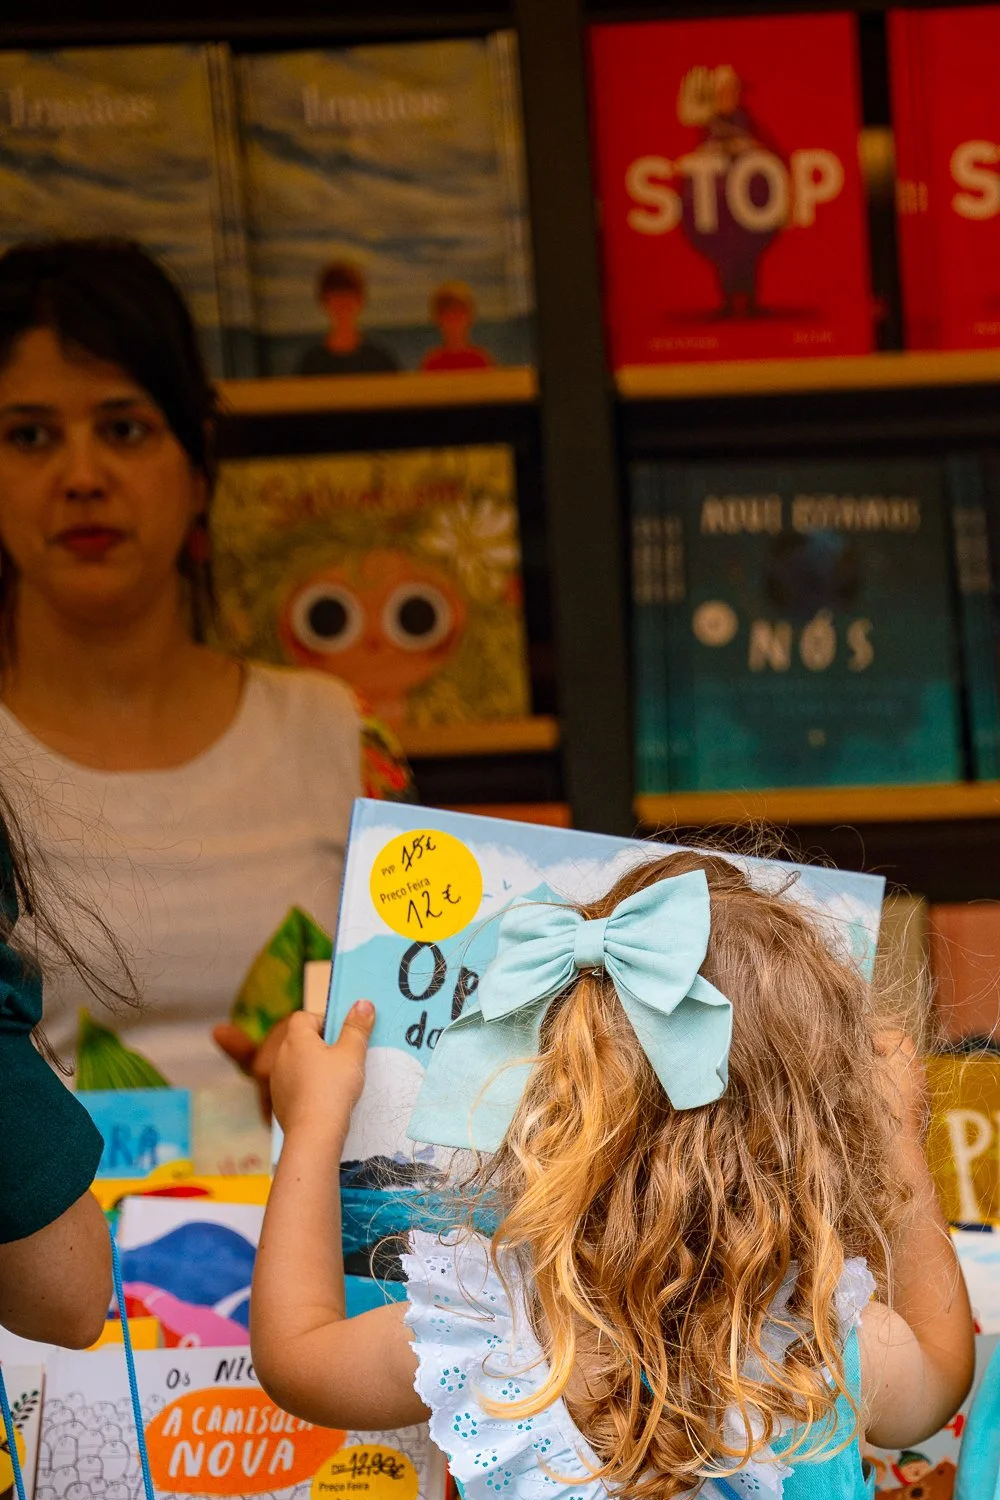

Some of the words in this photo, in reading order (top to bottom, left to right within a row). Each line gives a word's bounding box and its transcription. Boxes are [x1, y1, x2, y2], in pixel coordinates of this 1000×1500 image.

[625, 148, 844, 234] STOP
[748, 609, 874, 673] NÓS
[381, 864, 396, 877] PVP
[406, 878, 431, 892] Feira
[399, 941, 446, 1001] O
[162, 1406, 183, 1436] A
[168, 1438, 295, 1478] NOVA
